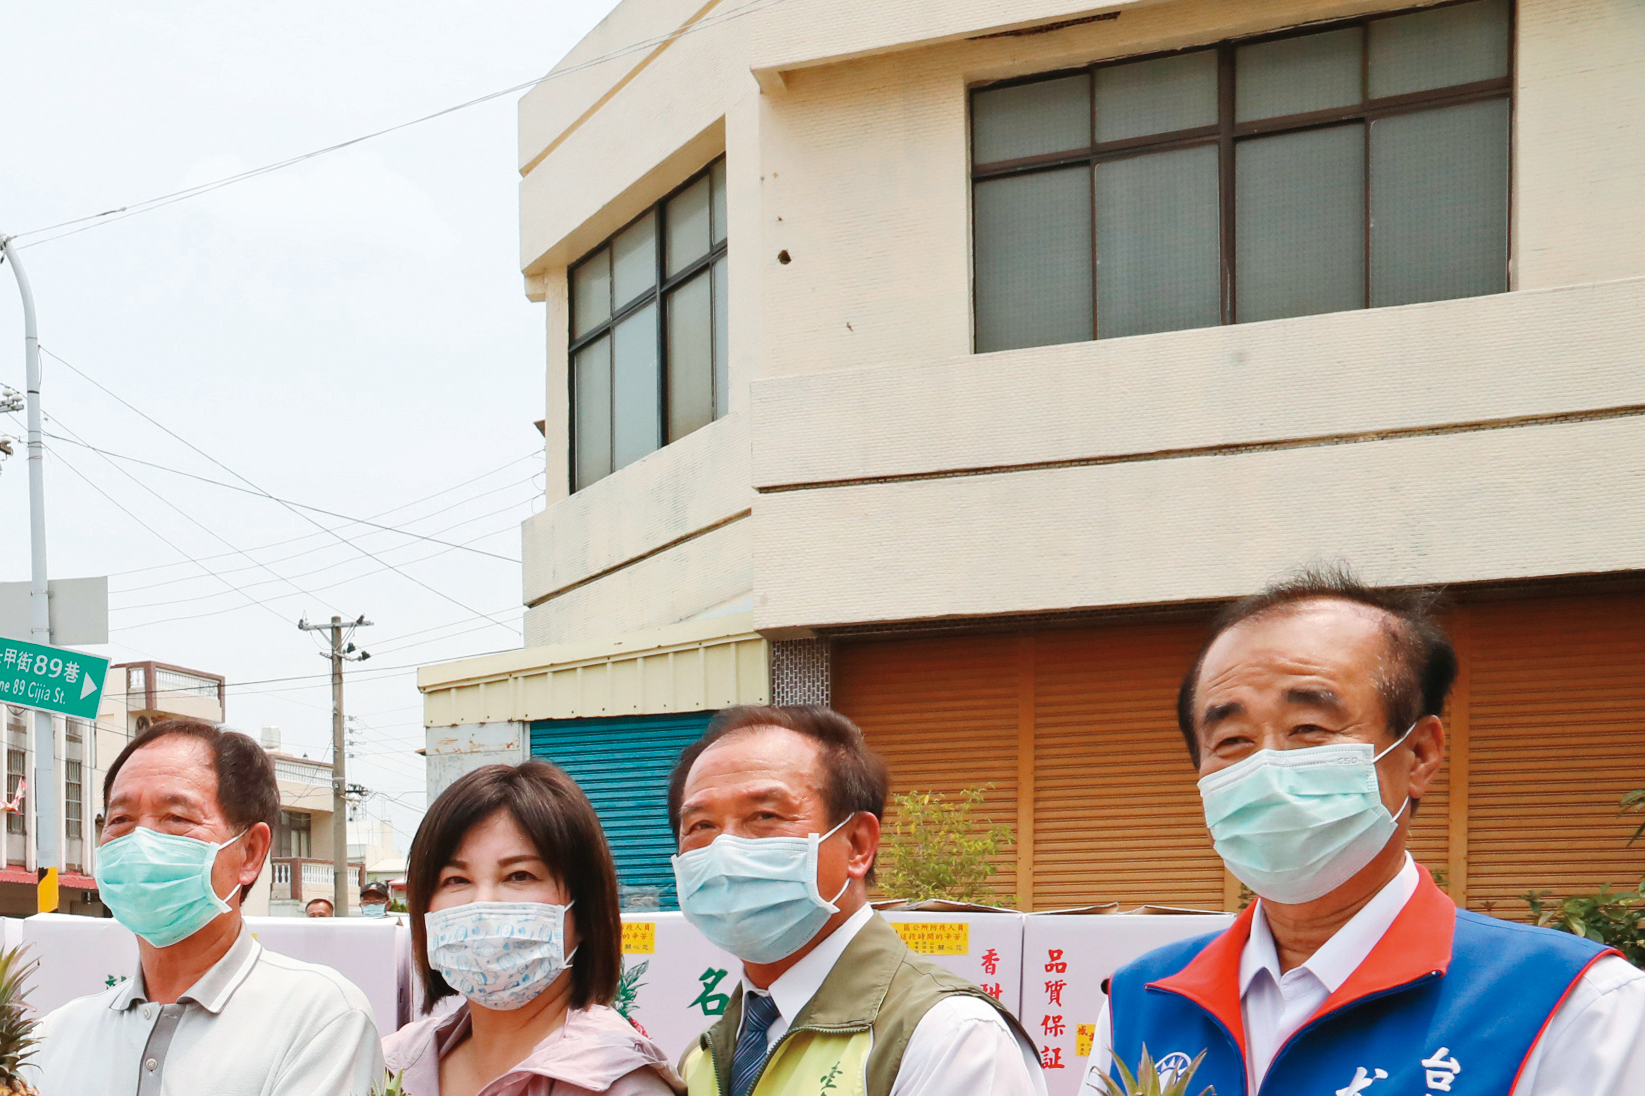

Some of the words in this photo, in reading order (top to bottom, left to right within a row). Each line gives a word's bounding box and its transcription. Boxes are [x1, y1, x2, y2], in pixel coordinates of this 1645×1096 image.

[13, 679, 26, 695] 89
[28, 682, 51, 703] Cijia
[53, 687, 66, 705] St.
[1041, 949, 1068, 1069] 品質保証
